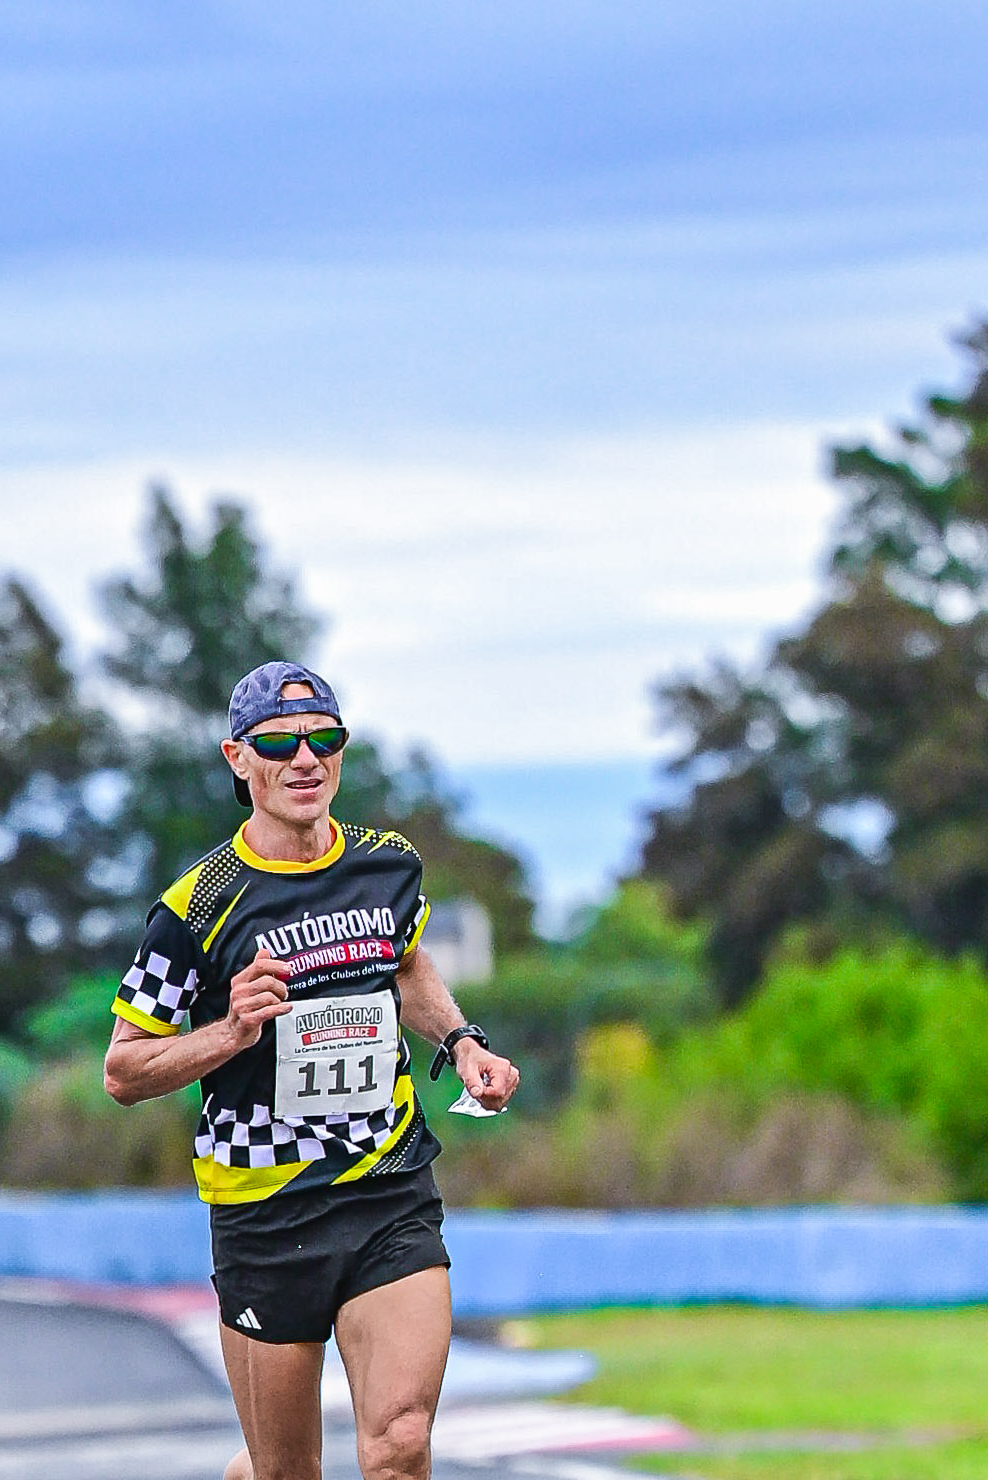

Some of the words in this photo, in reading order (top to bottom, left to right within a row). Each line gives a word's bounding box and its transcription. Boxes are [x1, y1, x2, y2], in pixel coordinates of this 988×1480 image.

[255, 907, 396, 958] AUTÓDROMO
[290, 945, 346, 976] RUNNING
[348, 942, 383, 960] RACE
[287, 981, 307, 991] rrera
[307, 976, 317, 986] de
[318, 973, 330, 983] los
[331, 968, 361, 980] Clubes
[361, 965, 375, 975] del
[296, 1005, 383, 1033] AUTÓDROMO
[310, 1028, 347, 1043] RUNNING
[348, 1027, 370, 1037] RACE
[337, 1042, 354, 1050] Clubes
[297, 1055, 377, 1097] 111
